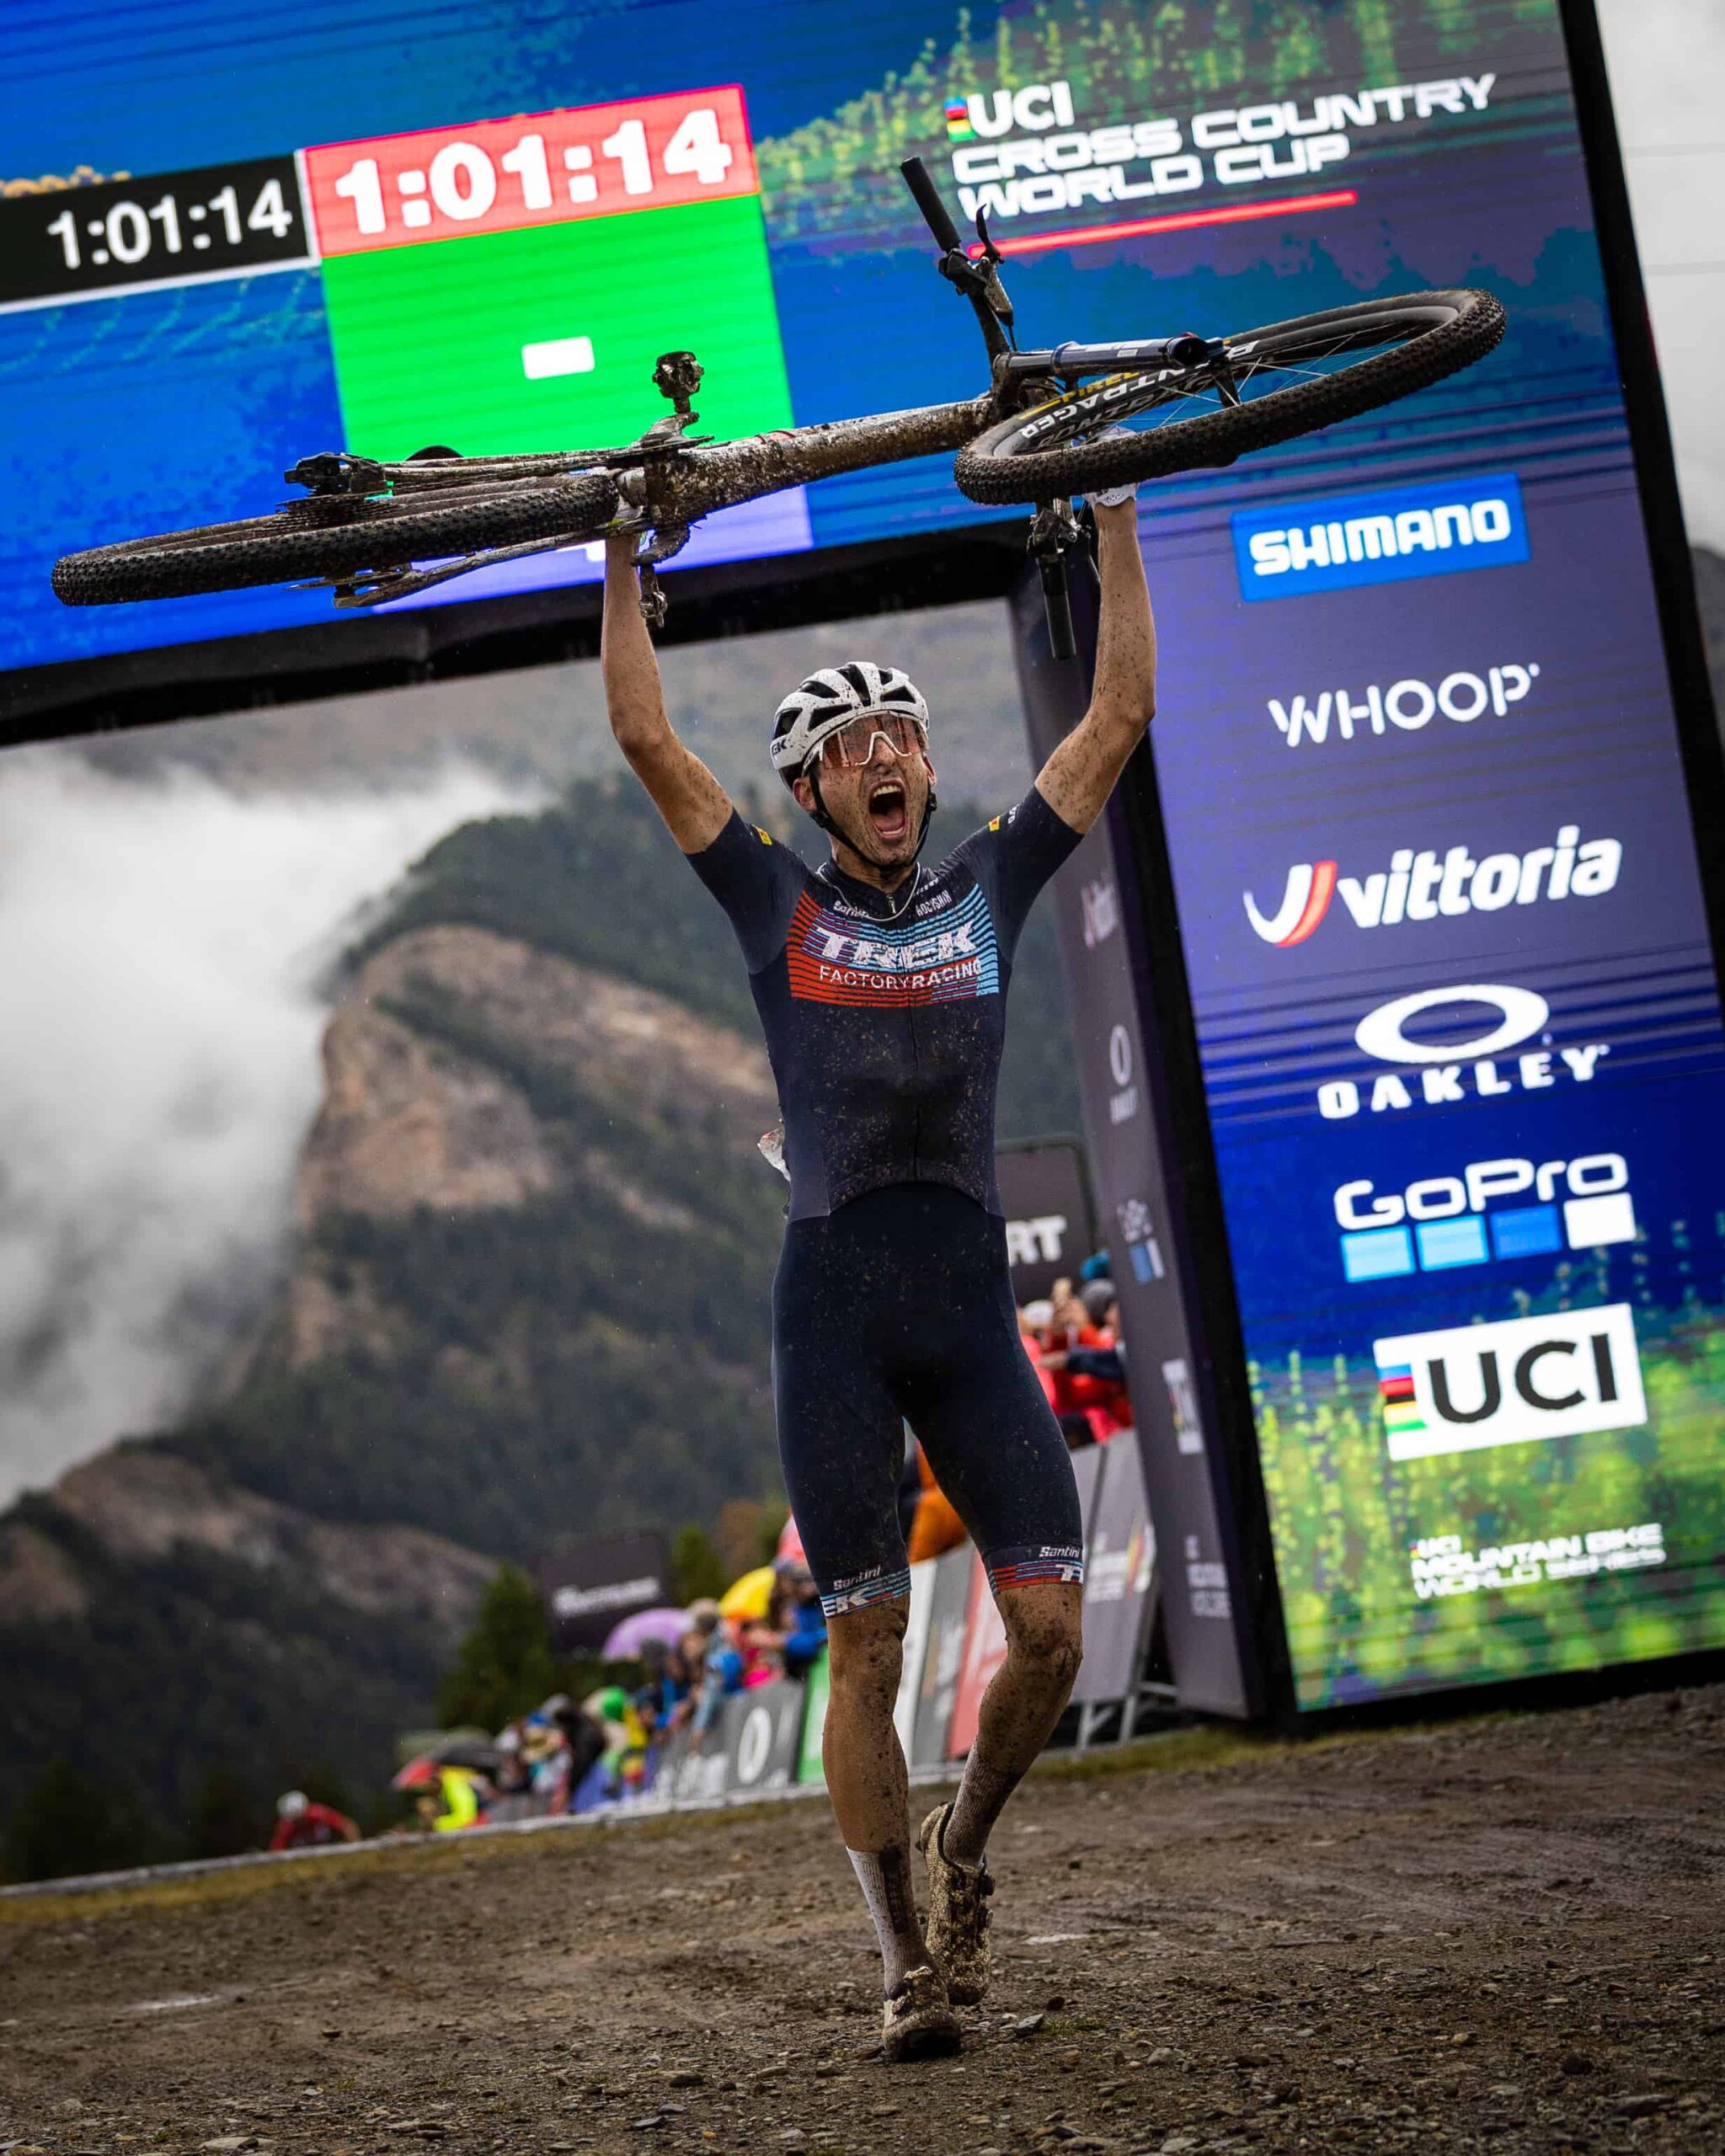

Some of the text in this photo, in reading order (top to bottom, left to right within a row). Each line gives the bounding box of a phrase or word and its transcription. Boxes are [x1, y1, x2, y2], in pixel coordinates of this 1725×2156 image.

[952, 73, 1496, 184] CROSS COUNTRY
[967, 81, 1075, 138] UCI
[335, 109, 733, 234] 1:01:14
[957, 134, 1350, 222] WORLD CUP
[47, 180, 293, 269] 1:01:14
[1020, 339, 1256, 440] BNTRAGER
[1249, 499, 1511, 576] SHIMANO
[1268, 664, 1535, 748] WHOOP
[1336, 825, 1622, 929] vittoria
[815, 920, 979, 969] TREK
[820, 958, 984, 990] FACTORY RACING
[1316, 1044, 1607, 1119] OAKLEY
[1333, 1153, 1628, 1230] GoPro
[1427, 1333, 1618, 1424] UCI
